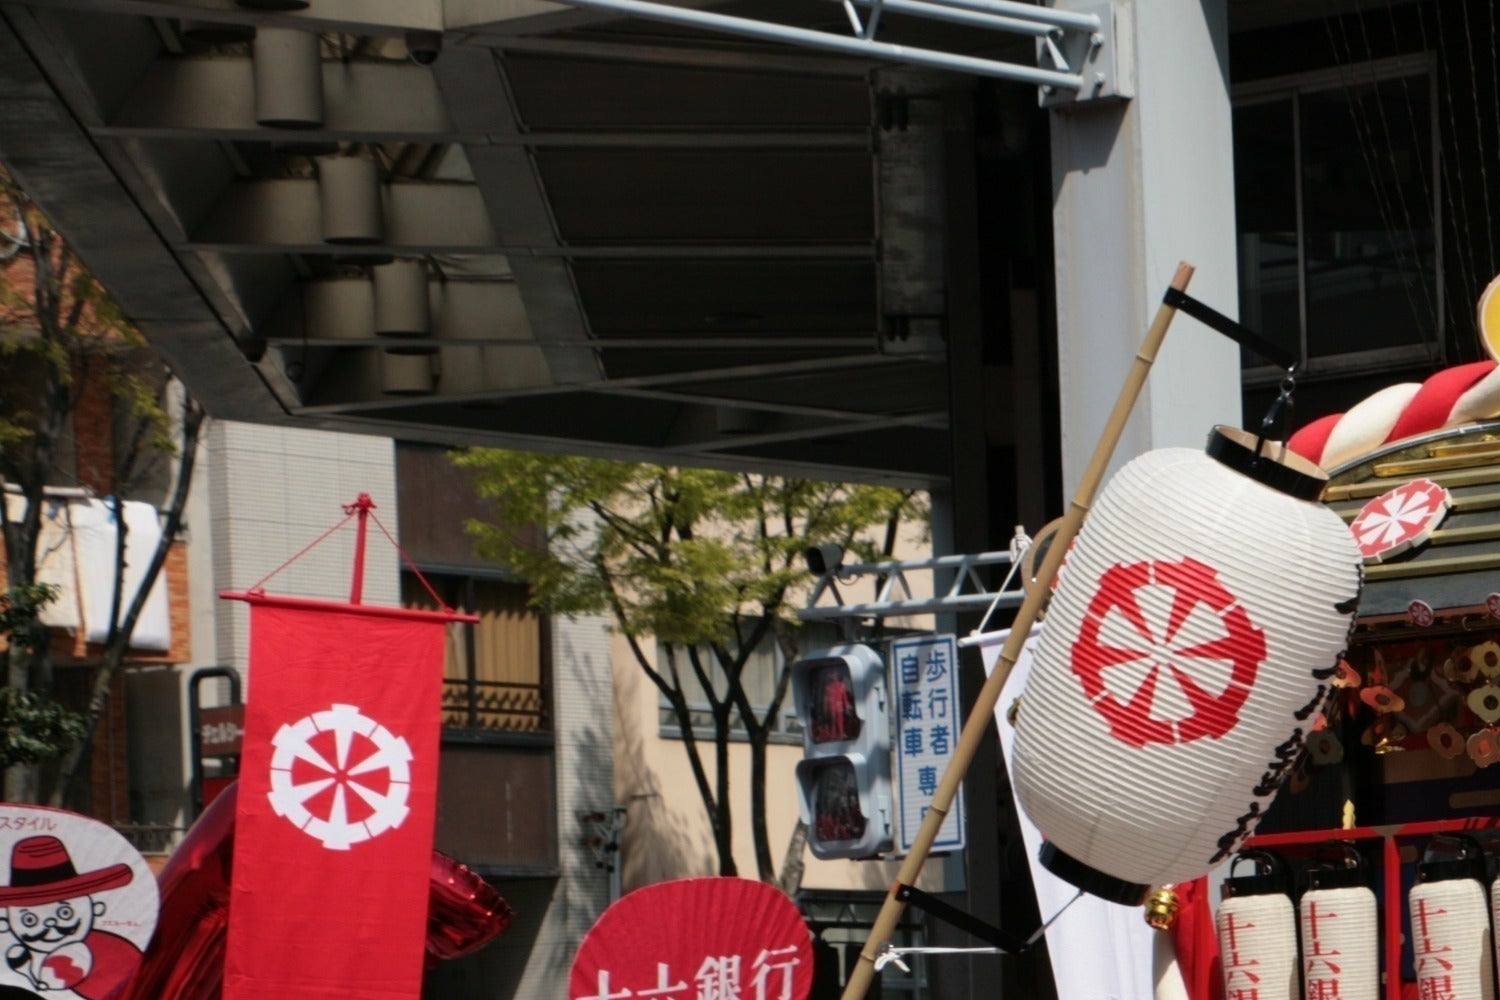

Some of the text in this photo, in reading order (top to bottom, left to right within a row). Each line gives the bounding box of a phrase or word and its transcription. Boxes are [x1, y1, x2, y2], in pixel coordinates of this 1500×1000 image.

[901, 655, 923, 757] 自転車
[925, 651, 950, 756] 歩行者
